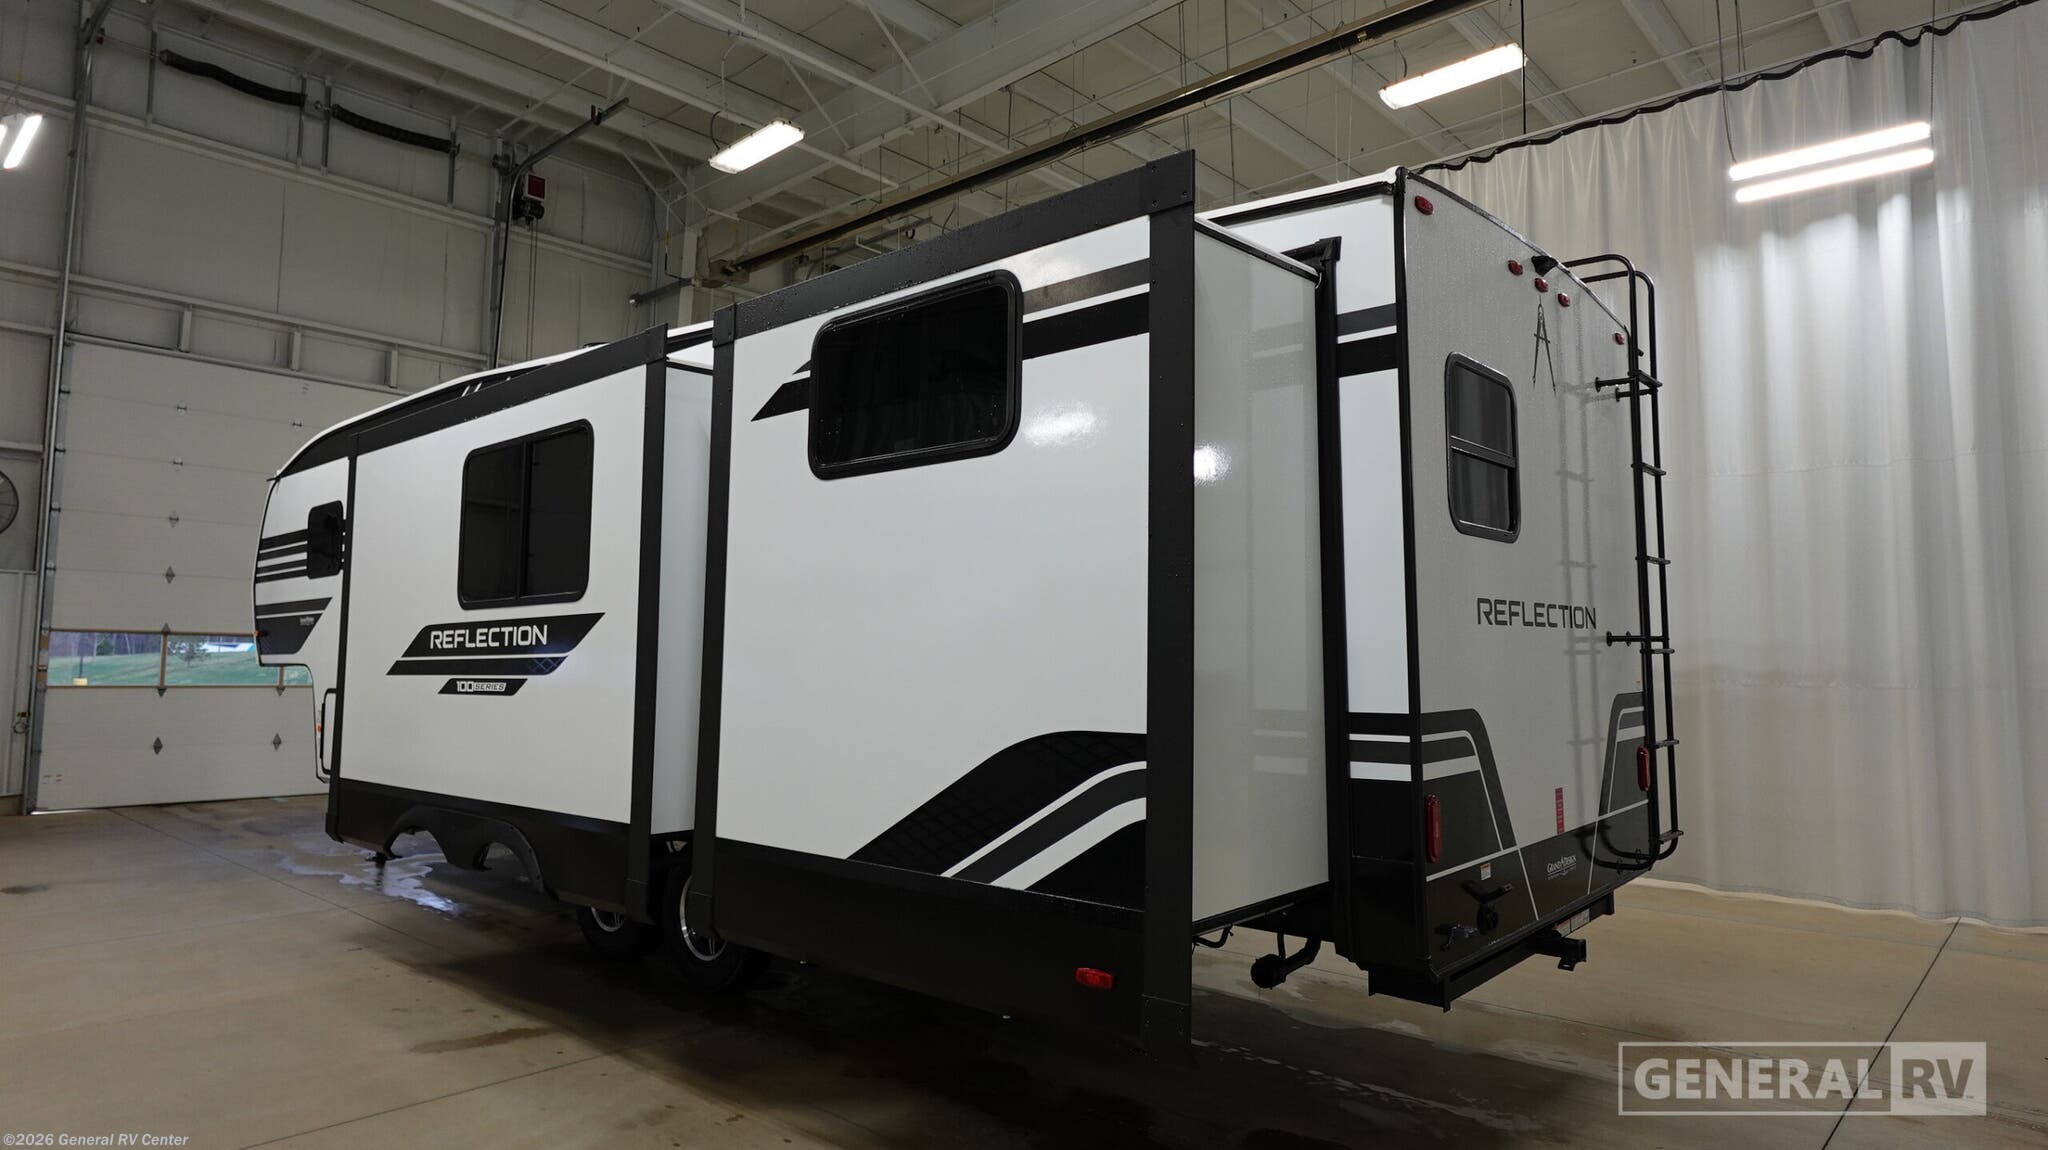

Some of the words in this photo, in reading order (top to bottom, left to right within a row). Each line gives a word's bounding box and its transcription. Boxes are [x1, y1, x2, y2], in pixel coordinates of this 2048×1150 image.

[1477, 597, 1597, 629] REFLECTION
[429, 624, 548, 650] REFLECTION
[456, 680, 474, 692] 100
[474, 682, 506, 691] SERIES
